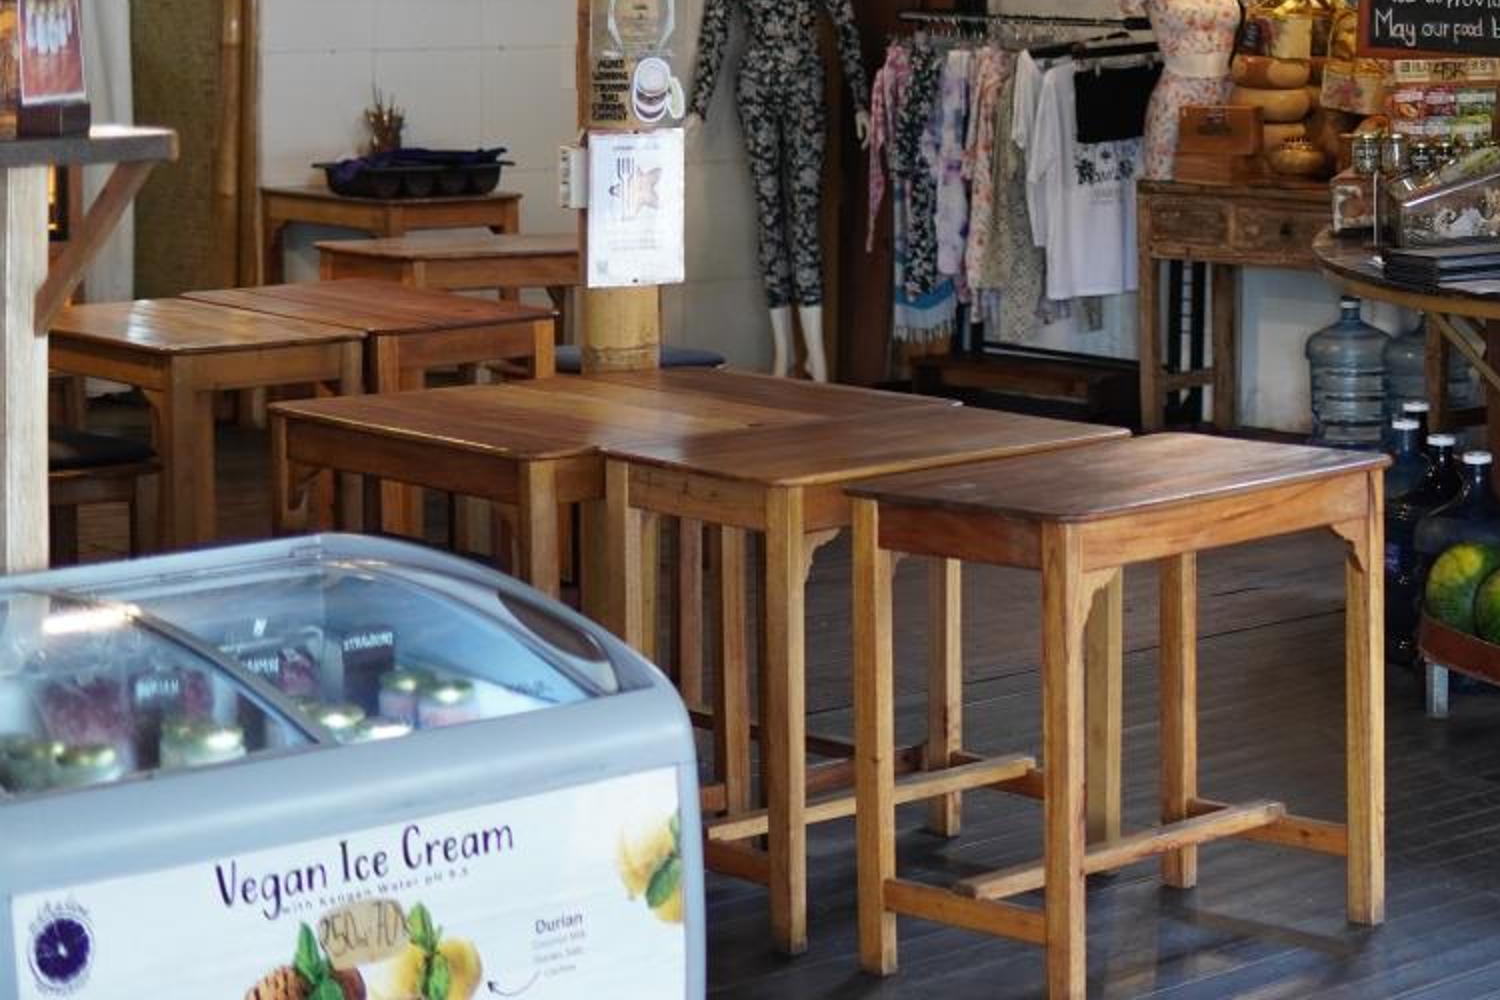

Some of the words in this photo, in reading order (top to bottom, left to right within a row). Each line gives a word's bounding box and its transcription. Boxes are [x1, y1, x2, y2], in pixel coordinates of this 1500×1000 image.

[215, 859, 327, 921] Vegan
[338, 839, 389, 885] Ice
[401, 823, 514, 871] Cream
[534, 912, 584, 935] Durian
